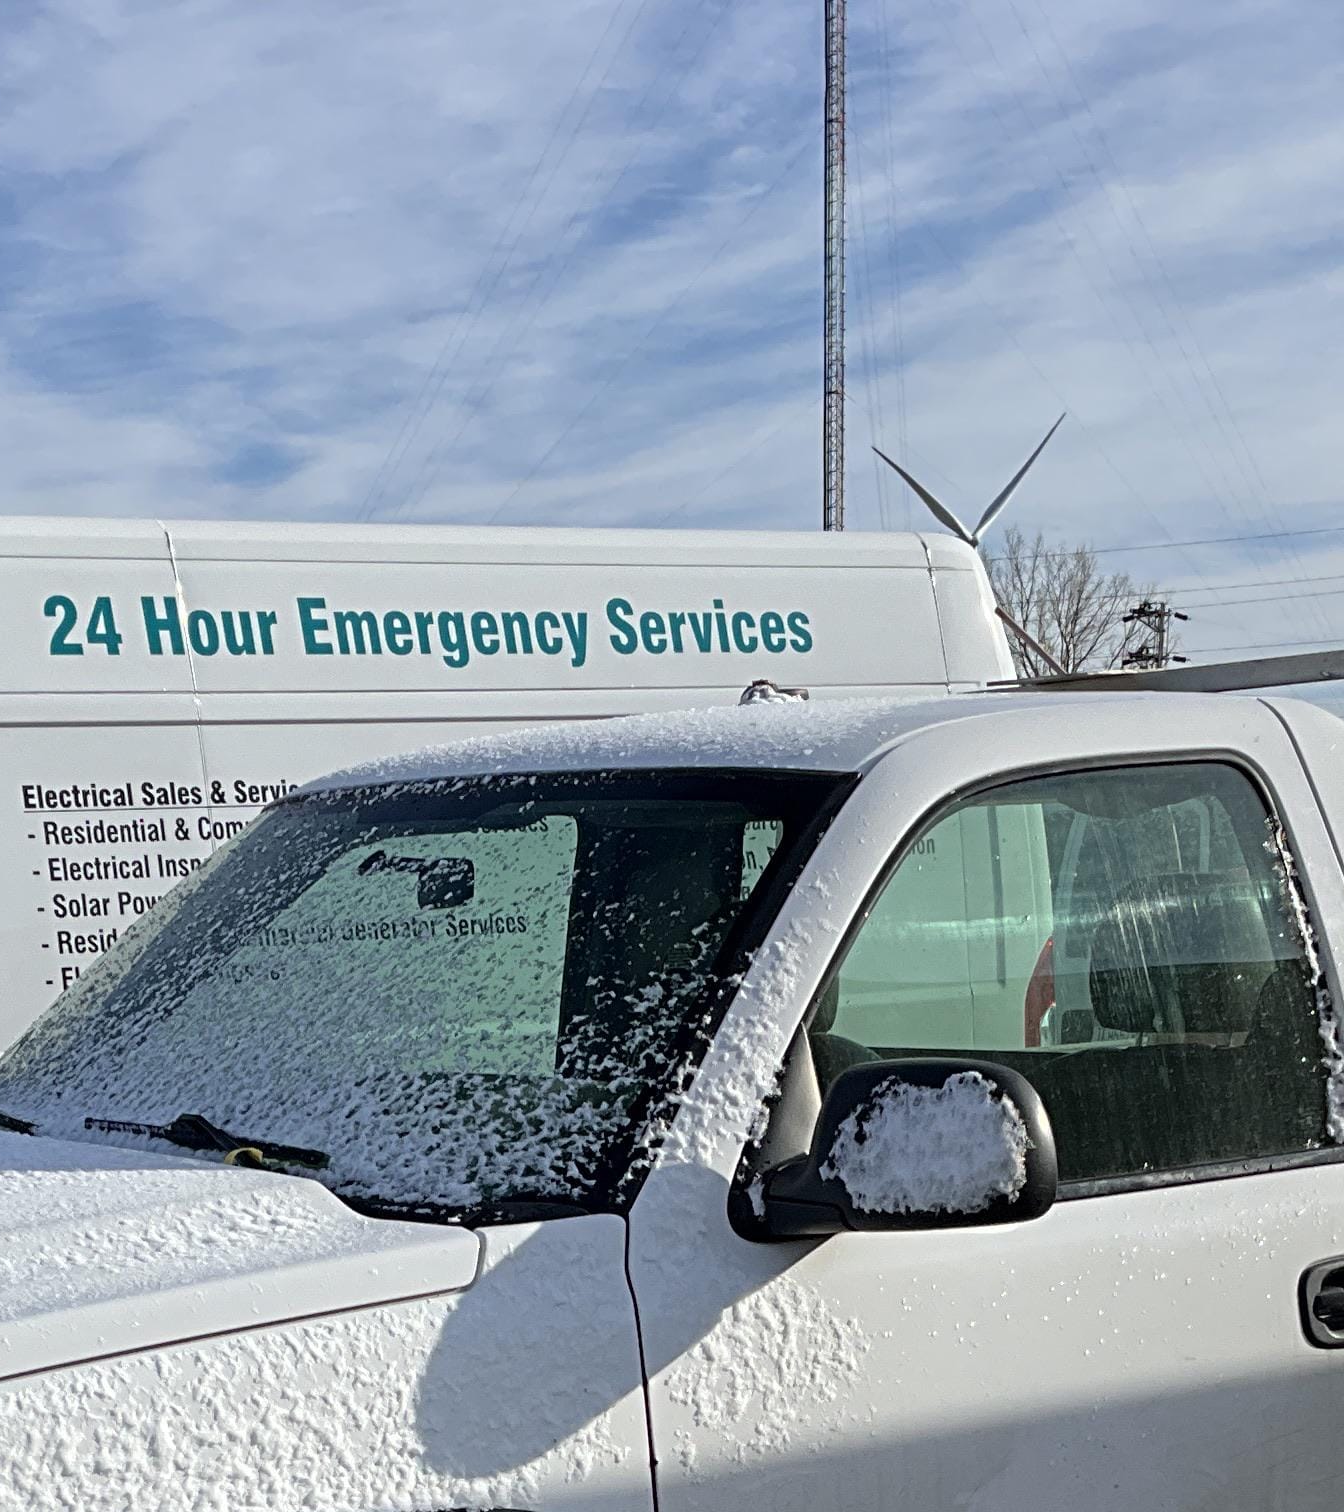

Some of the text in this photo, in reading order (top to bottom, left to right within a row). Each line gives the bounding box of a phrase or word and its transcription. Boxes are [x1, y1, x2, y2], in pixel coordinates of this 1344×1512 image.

[43, 594, 813, 669] 24 Hour Emergency Services
[22, 783, 135, 809] Electrical
[141, 782, 202, 807] Sales
[210, 780, 227, 804] &
[43, 818, 167, 845] Residential
[174, 817, 190, 841] &
[198, 816, 249, 840] Com
[47, 855, 151, 881] Electrical
[53, 892, 111, 918] Solar
[445, 914, 528, 938] Services
